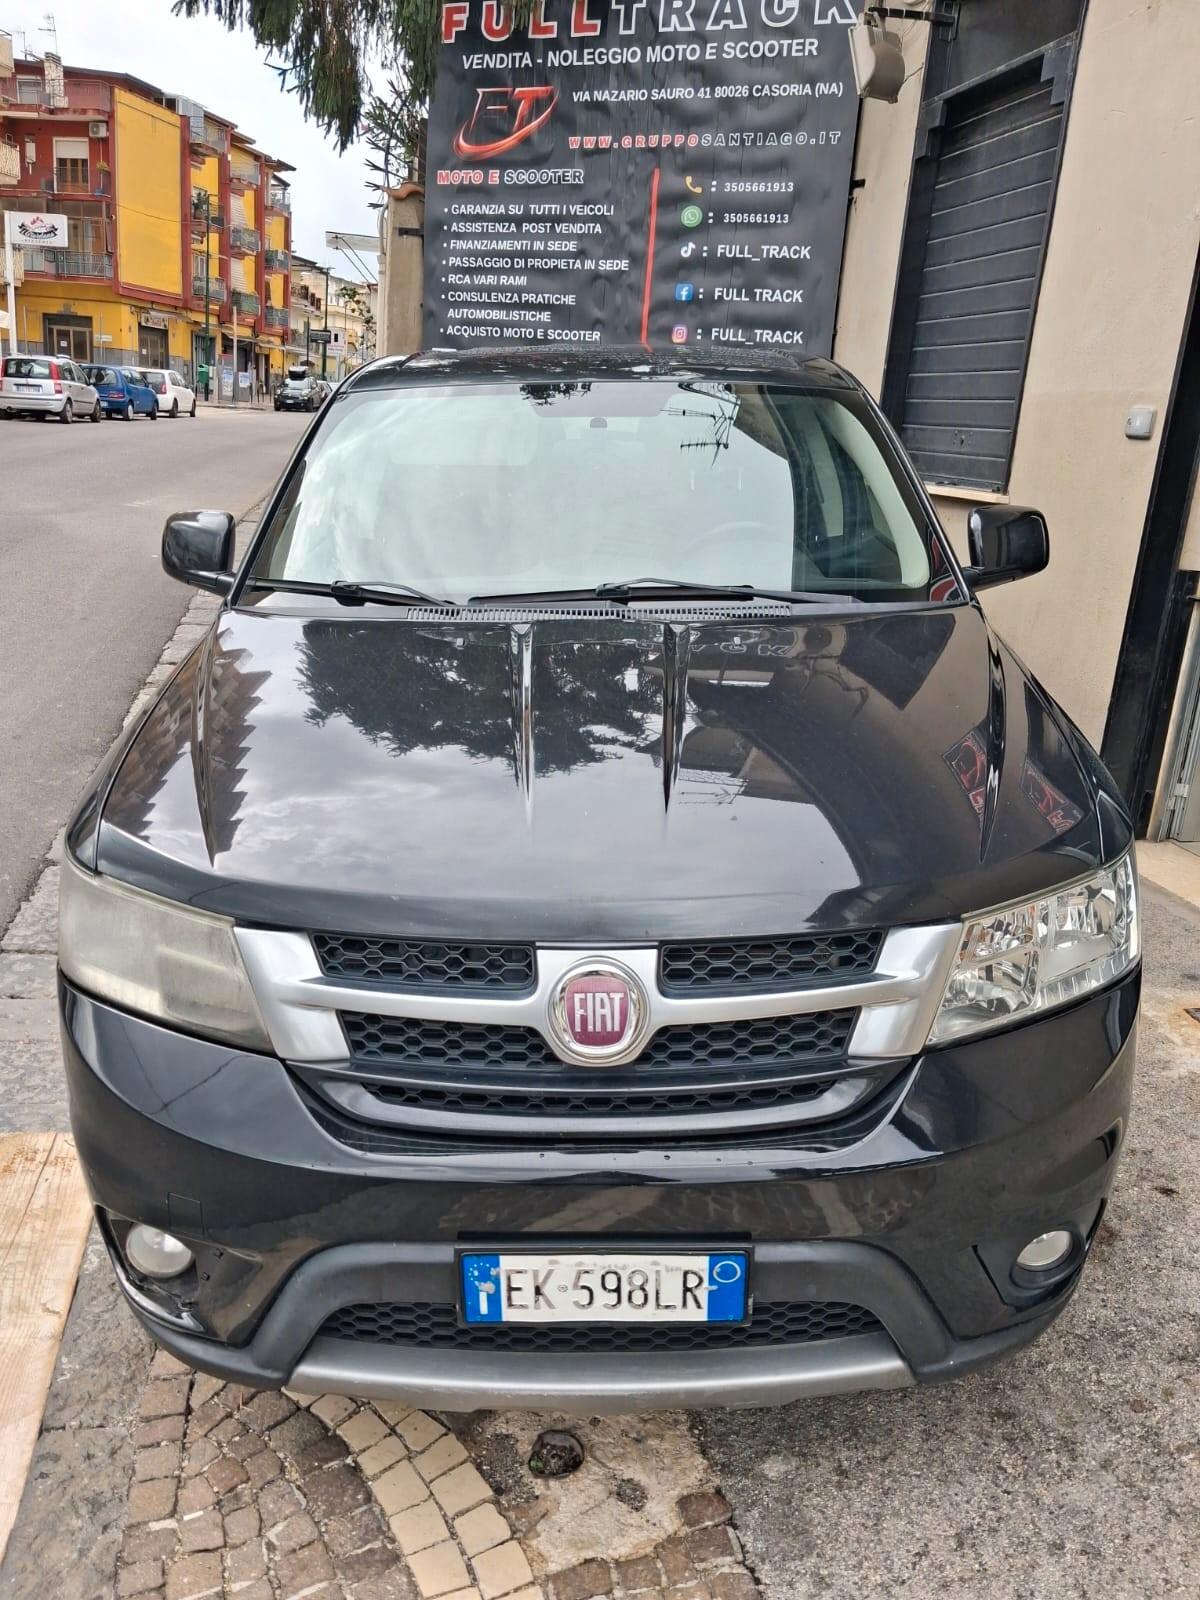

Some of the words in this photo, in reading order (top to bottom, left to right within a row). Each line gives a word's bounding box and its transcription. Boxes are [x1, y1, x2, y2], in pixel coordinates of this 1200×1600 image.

[462, 51, 533, 70] VENDITA
[547, 46, 642, 67] NOLEGGIO
[646, 44, 700, 63] MOTO
[705, 43, 718, 60] E
[722, 38, 818, 59] SCOOTER
[573, 90, 591, 102] VIA
[593, 89, 648, 102] NAZARIO
[651, 87, 695, 100] SAURO
[697, 87, 712, 99] 41
[714, 85, 749, 98] 80026
[752, 83, 812, 97] CASORIA
[815, 82, 844, 97] (NA)
[568, 131, 842, 149] WWW.GRUPPOSANTIAGO.IT
[437, 169, 484, 185] MOTO
[488, 170, 500, 185] E
[504, 168, 584, 185] SCOOTER
[723, 182, 794, 192] 3505661913
[451, 204, 506, 215] GARANZIA
[507, 204, 524, 215] SU
[529, 204, 560, 215] TUTTI
[562, 205, 567, 215] I
[569, 205, 614, 216] VEICOLI
[723, 213, 789, 223] 3505661913
[450, 222, 517, 233] ASSISTENZA
[522, 223, 551, 233] POST
[555, 223, 602, 234] VENDITA
[450, 239, 531, 250] FINANZIAMENTI
[533, 240, 544, 251] IN
[547, 240, 578, 251] SEDE
[717, 244, 812, 261] FULL_TRACK
[448, 257, 511, 268] PASSAGGIO
[514, 258, 525, 269] DI
[527, 258, 582, 269] PROPIETA
[584, 259, 595, 270] IN
[598, 260, 630, 270] SEDE
[448, 274, 471, 285] RCA
[473, 275, 497, 285] VARI
[499, 275, 528, 286] RAMI
[447, 291, 520, 304] CONSULENZA
[521, 293, 577, 305] PRATICHE
[714, 287, 750, 301] FULL
[754, 288, 804, 303] TRACK
[447, 308, 552, 322] AUTOMOBILISTICHE
[446, 325, 501, 338] ACQUISTO
[503, 327, 534, 339] MOTO
[537, 328, 545, 339] E
[547, 329, 601, 341] SCOOTER
[711, 327, 804, 345] FULL_TRACK
[573, 992, 625, 1032] FIAT
